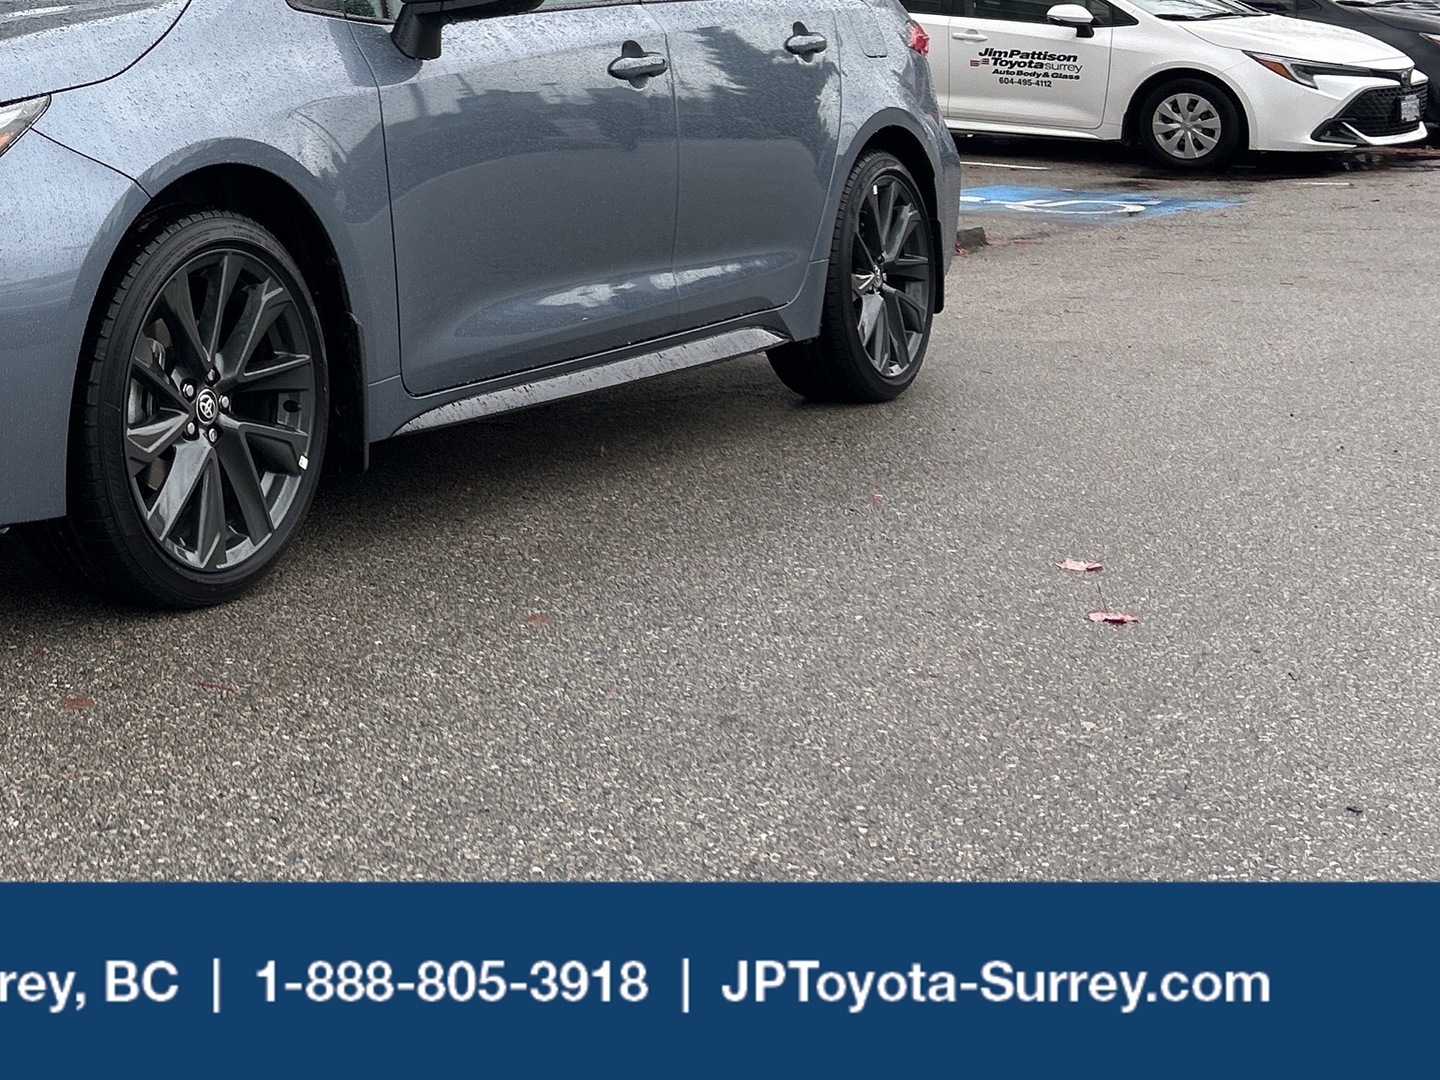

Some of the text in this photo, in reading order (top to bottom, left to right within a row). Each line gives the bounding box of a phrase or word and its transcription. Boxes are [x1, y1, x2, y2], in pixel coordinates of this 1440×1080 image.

[992, 68, 1015, 76] Auto
[1051, 72, 1080, 80] Glass
[998, 77, 1052, 87] 604-495-4112
